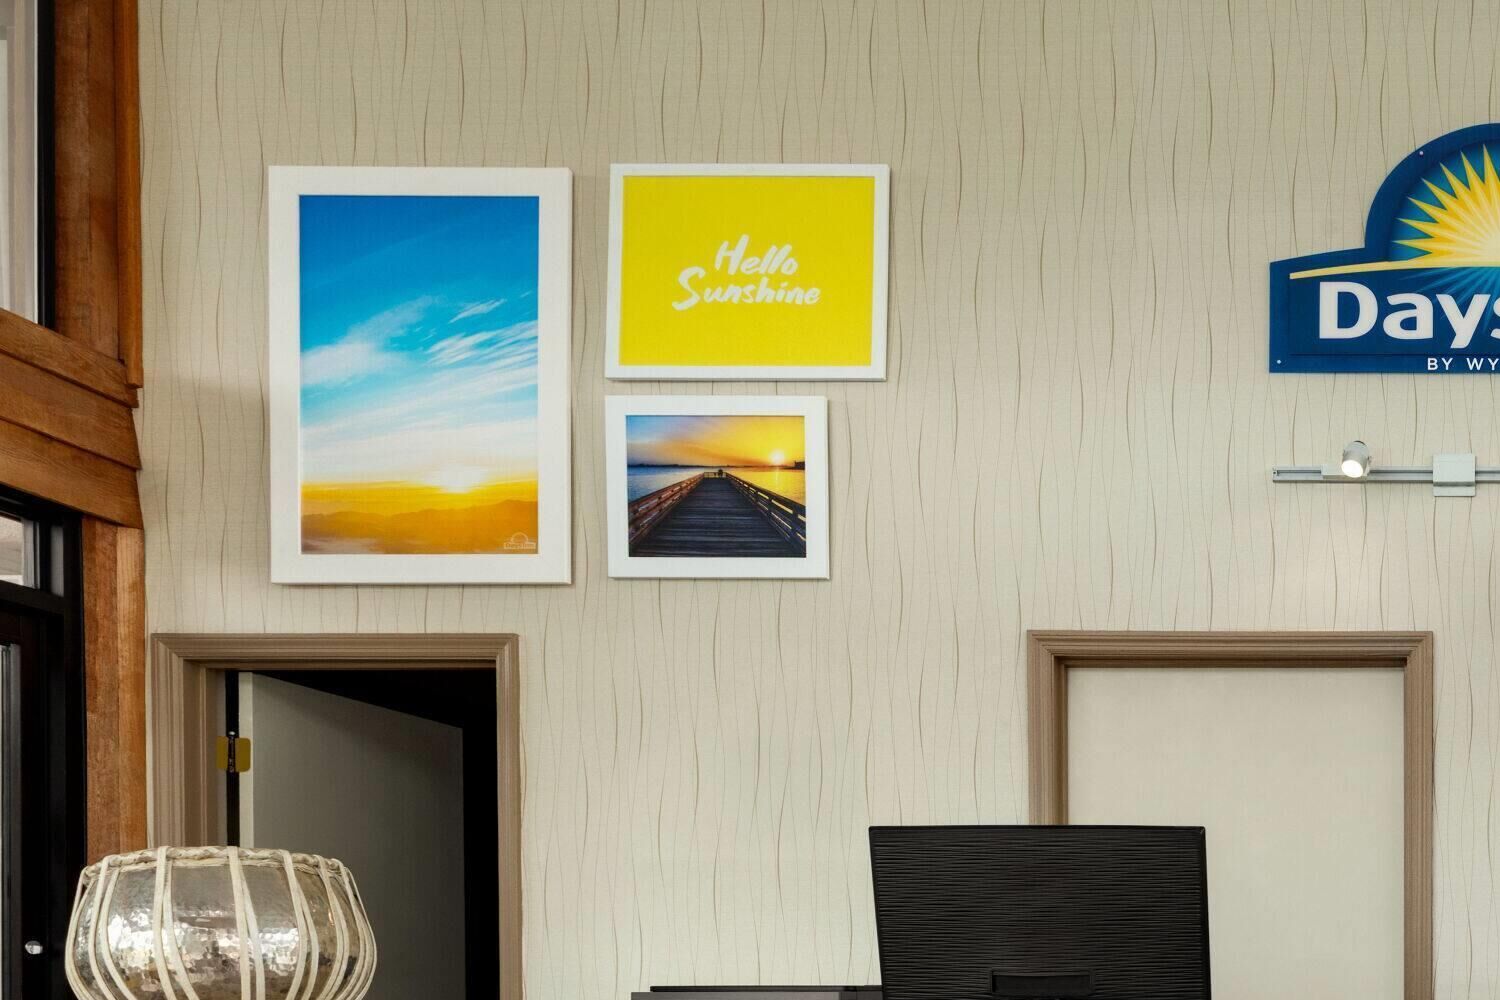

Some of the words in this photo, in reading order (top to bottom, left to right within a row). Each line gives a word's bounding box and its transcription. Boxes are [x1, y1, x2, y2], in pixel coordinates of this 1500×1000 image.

[714, 234, 799, 275] Hello
[671, 266, 821, 311] Sunshine
[1427, 357, 1453, 371] BY
